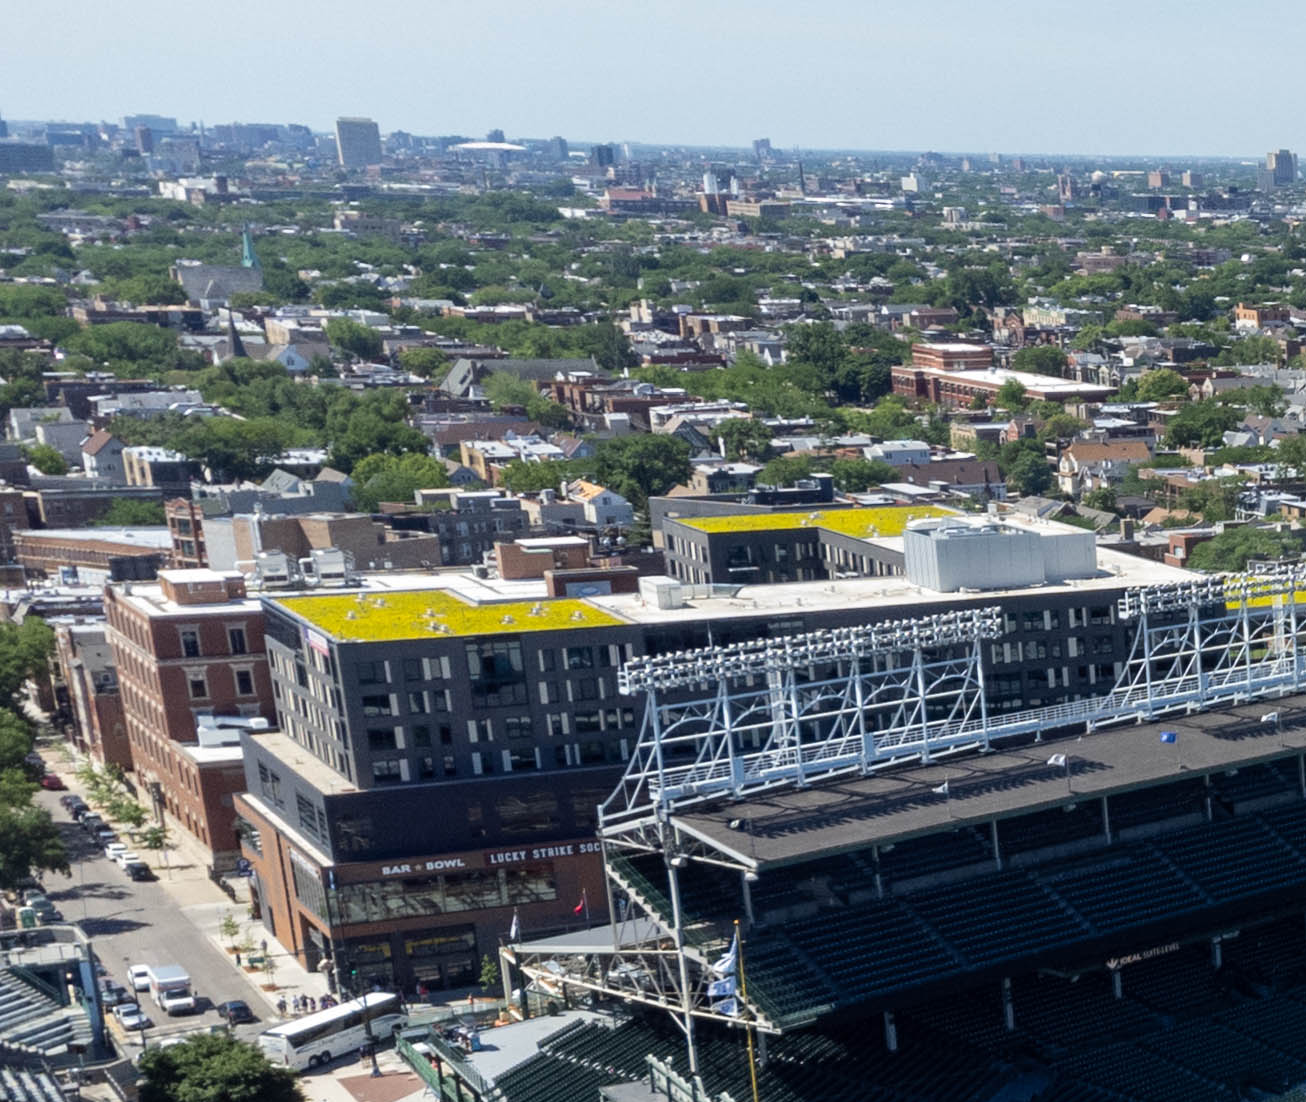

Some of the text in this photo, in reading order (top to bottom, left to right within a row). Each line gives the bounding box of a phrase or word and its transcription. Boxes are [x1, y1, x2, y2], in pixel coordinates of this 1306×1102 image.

[490, 851, 526, 864] LUCKY
[533, 846, 574, 860] STRIKE
[382, 859, 465, 876] BAR BOWL
